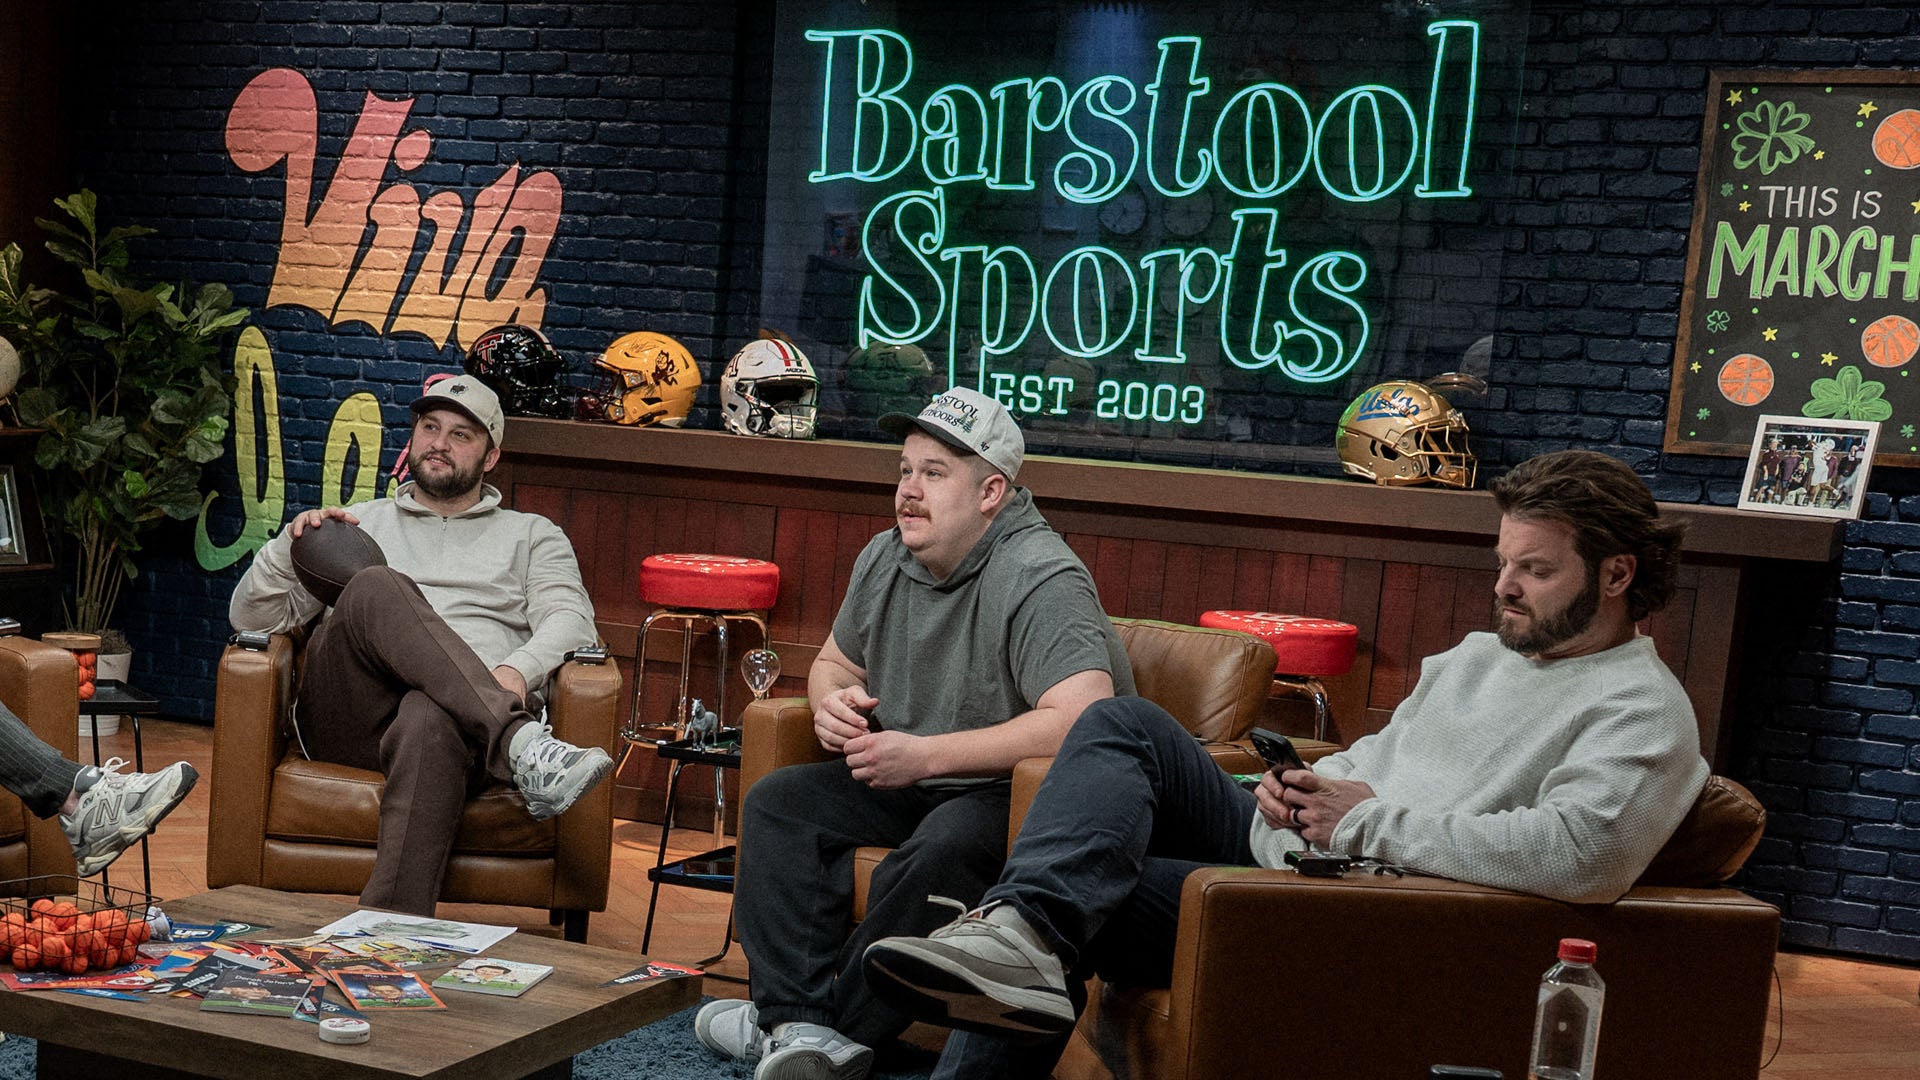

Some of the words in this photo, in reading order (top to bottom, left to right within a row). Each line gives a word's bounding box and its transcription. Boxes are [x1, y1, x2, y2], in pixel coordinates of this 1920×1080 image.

[804, 20, 1480, 205] Barstool
[224, 67, 564, 352] Viva
[1706, 220, 1920, 301] MARCH
[1758, 185, 1840, 218] THIS
[1851, 189, 1883, 219] IS
[859, 186, 1370, 400] Sports
[989, 372, 1074, 415] EST
[1096, 380, 1206, 425] 2003
